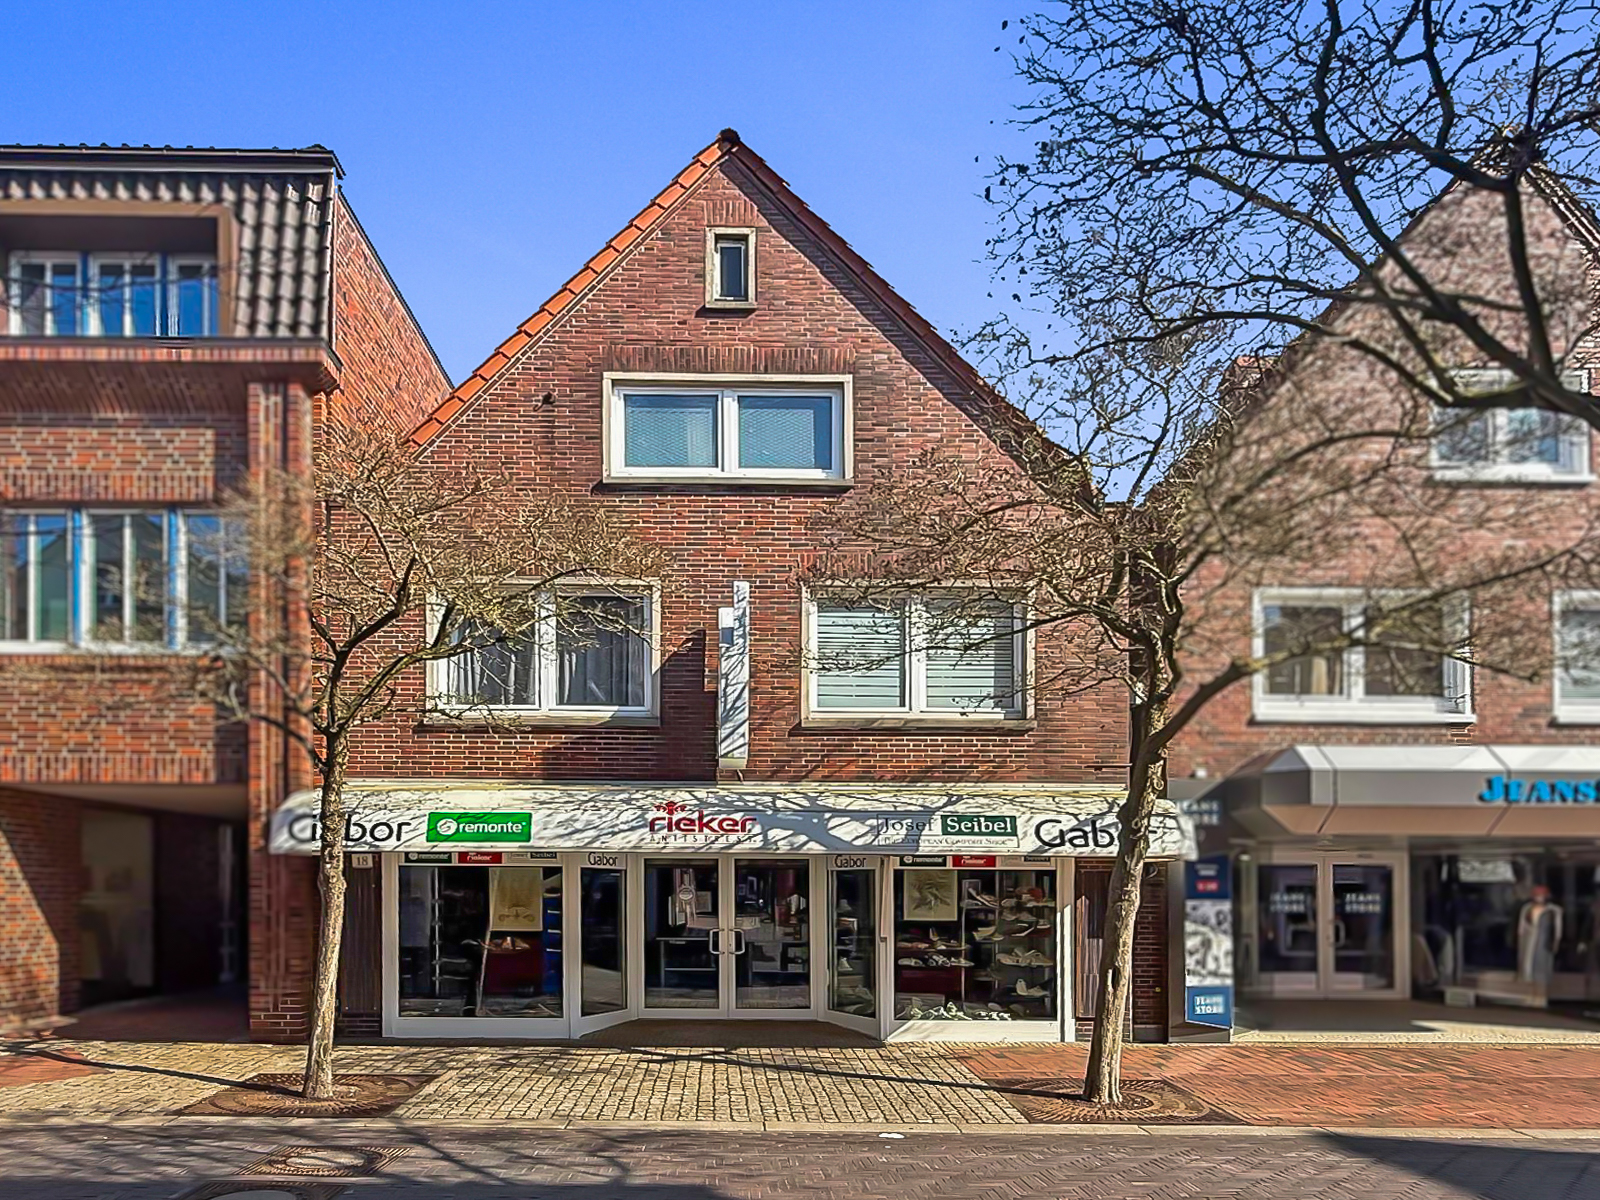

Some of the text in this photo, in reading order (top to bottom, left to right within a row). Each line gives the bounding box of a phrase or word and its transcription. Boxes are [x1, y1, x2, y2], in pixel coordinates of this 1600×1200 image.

[288, 814, 411, 842] Gbor
[459, 821, 523, 833] remonte
[649, 809, 757, 833] rieker
[880, 817, 1012, 833] Josef Seibel
[1034, 819, 1157, 848] Gab
[356, 855, 369, 866] 18
[588, 851, 618, 867] Gabor
[834, 854, 866, 868] Gabor
